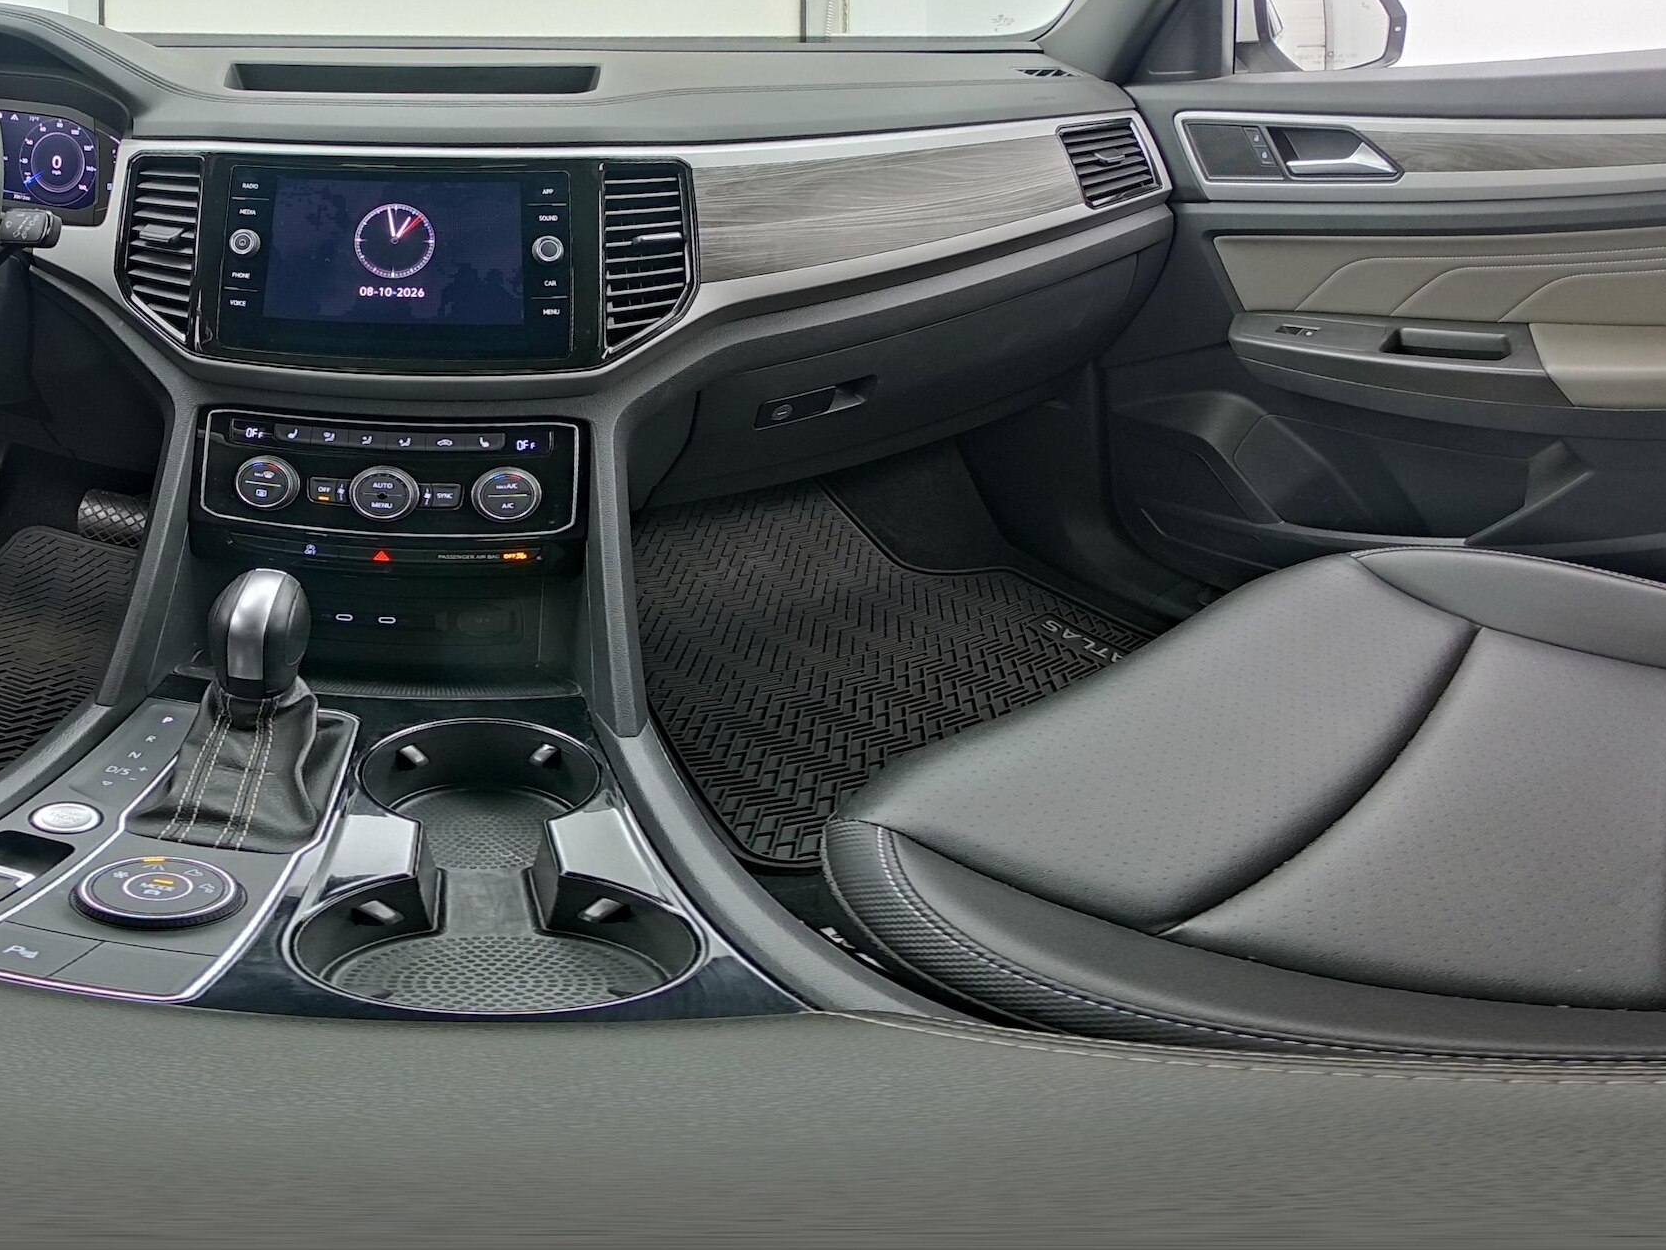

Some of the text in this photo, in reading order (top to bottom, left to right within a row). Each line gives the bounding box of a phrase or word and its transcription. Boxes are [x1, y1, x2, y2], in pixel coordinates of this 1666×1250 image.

[52, 155, 62, 169] 0
[239, 208, 257, 216] MEDIA
[231, 271, 251, 279] PHONE
[359, 286, 425, 298] 08-10-2026
[229, 299, 246, 307] VOICE
[437, 492, 454, 500] SYNC
[162, 716, 174, 724] P
[145, 735, 157, 743] R
[127, 751, 142, 759] N
[105, 765, 132, 776] D/S
[140, 882, 175, 892] MODE
